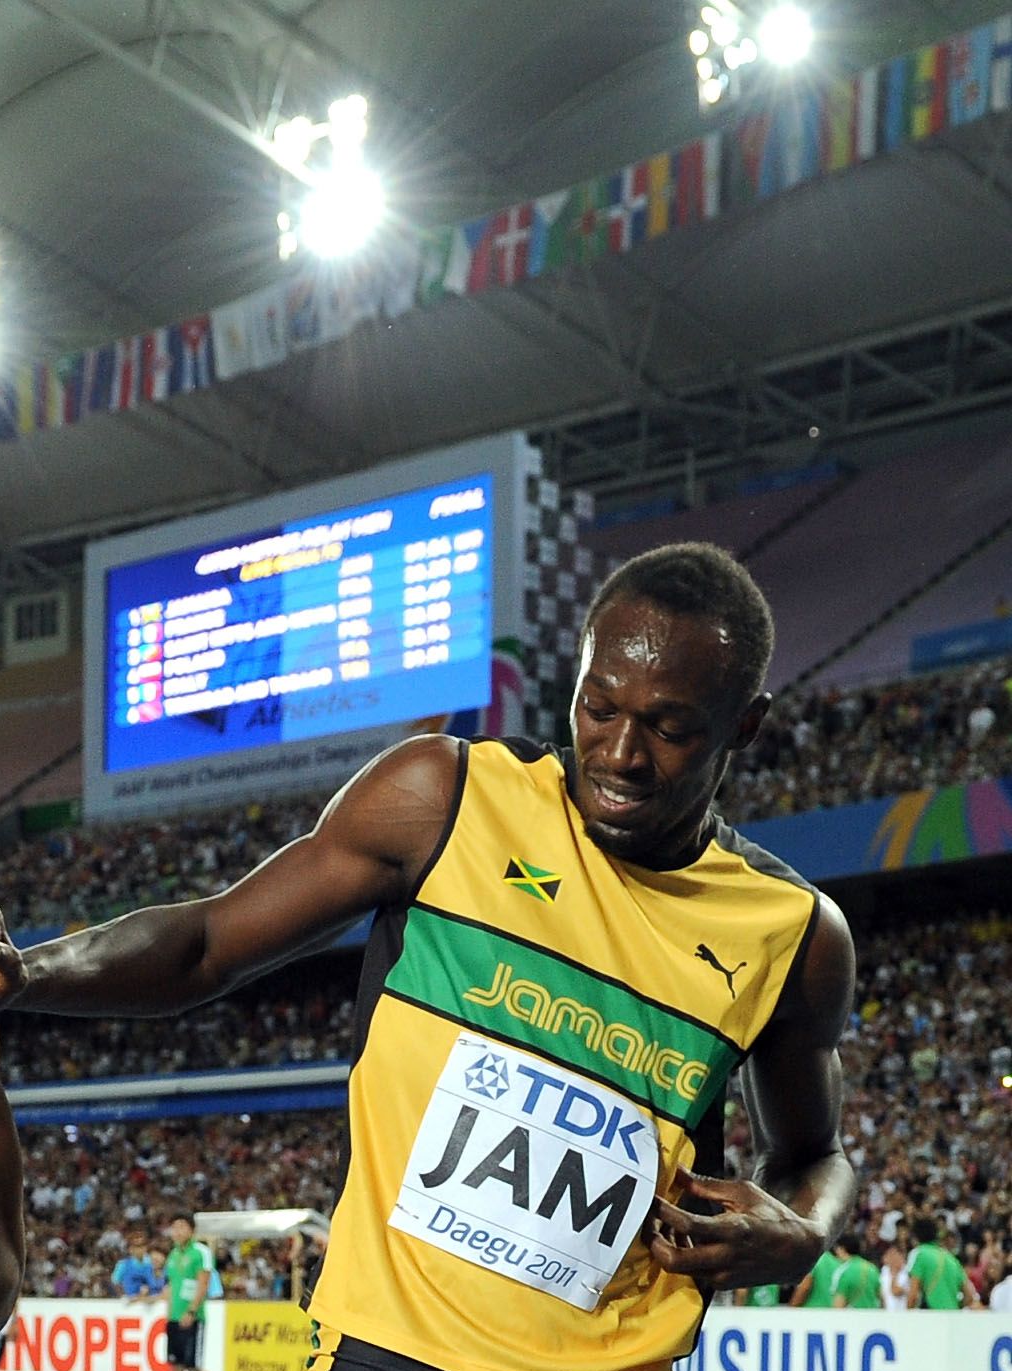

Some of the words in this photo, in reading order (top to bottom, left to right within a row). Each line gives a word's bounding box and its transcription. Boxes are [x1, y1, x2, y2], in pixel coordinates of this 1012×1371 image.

[462, 962, 711, 1099] Jamaica
[517, 1063, 646, 1164] TDK
[419, 1105, 638, 1248] JAM
[427, 1205, 528, 1267] Daegu
[526, 1253, 578, 1287] 2011
